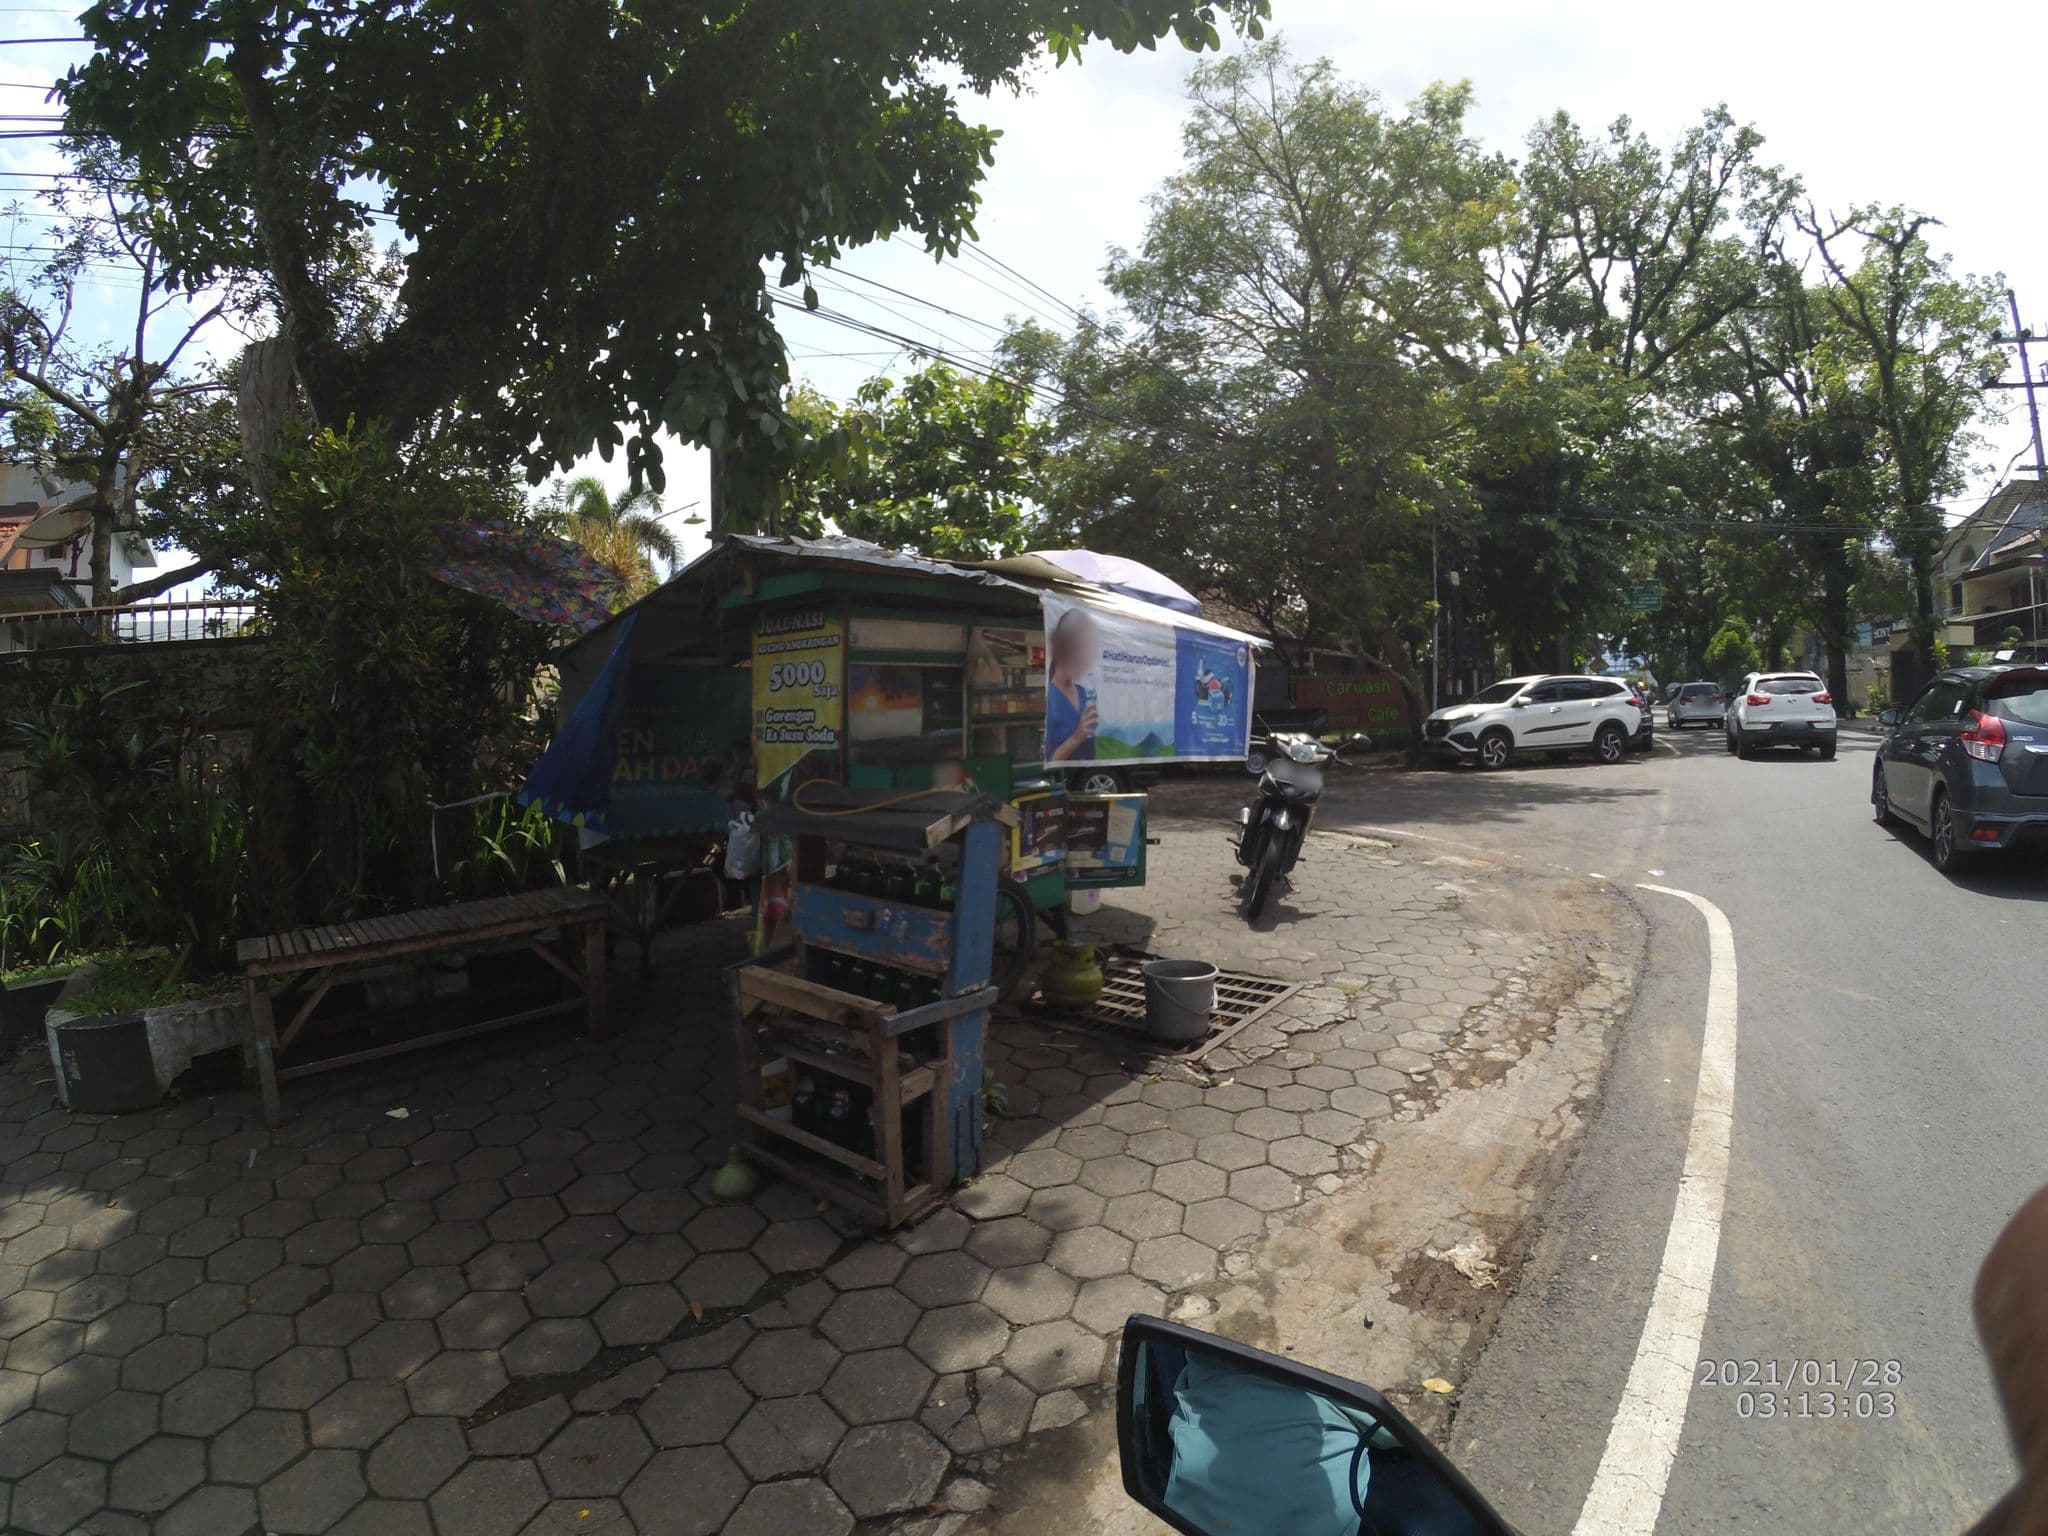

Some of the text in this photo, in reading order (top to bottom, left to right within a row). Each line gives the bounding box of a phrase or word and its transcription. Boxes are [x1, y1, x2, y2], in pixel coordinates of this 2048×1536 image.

[791, 609, 825, 630] NASI
[769, 661, 825, 692] 5000
[813, 684, 839, 699] Saja
[765, 708, 815, 725] Gorengan
[766, 726, 835, 742] Es Susu Soda
